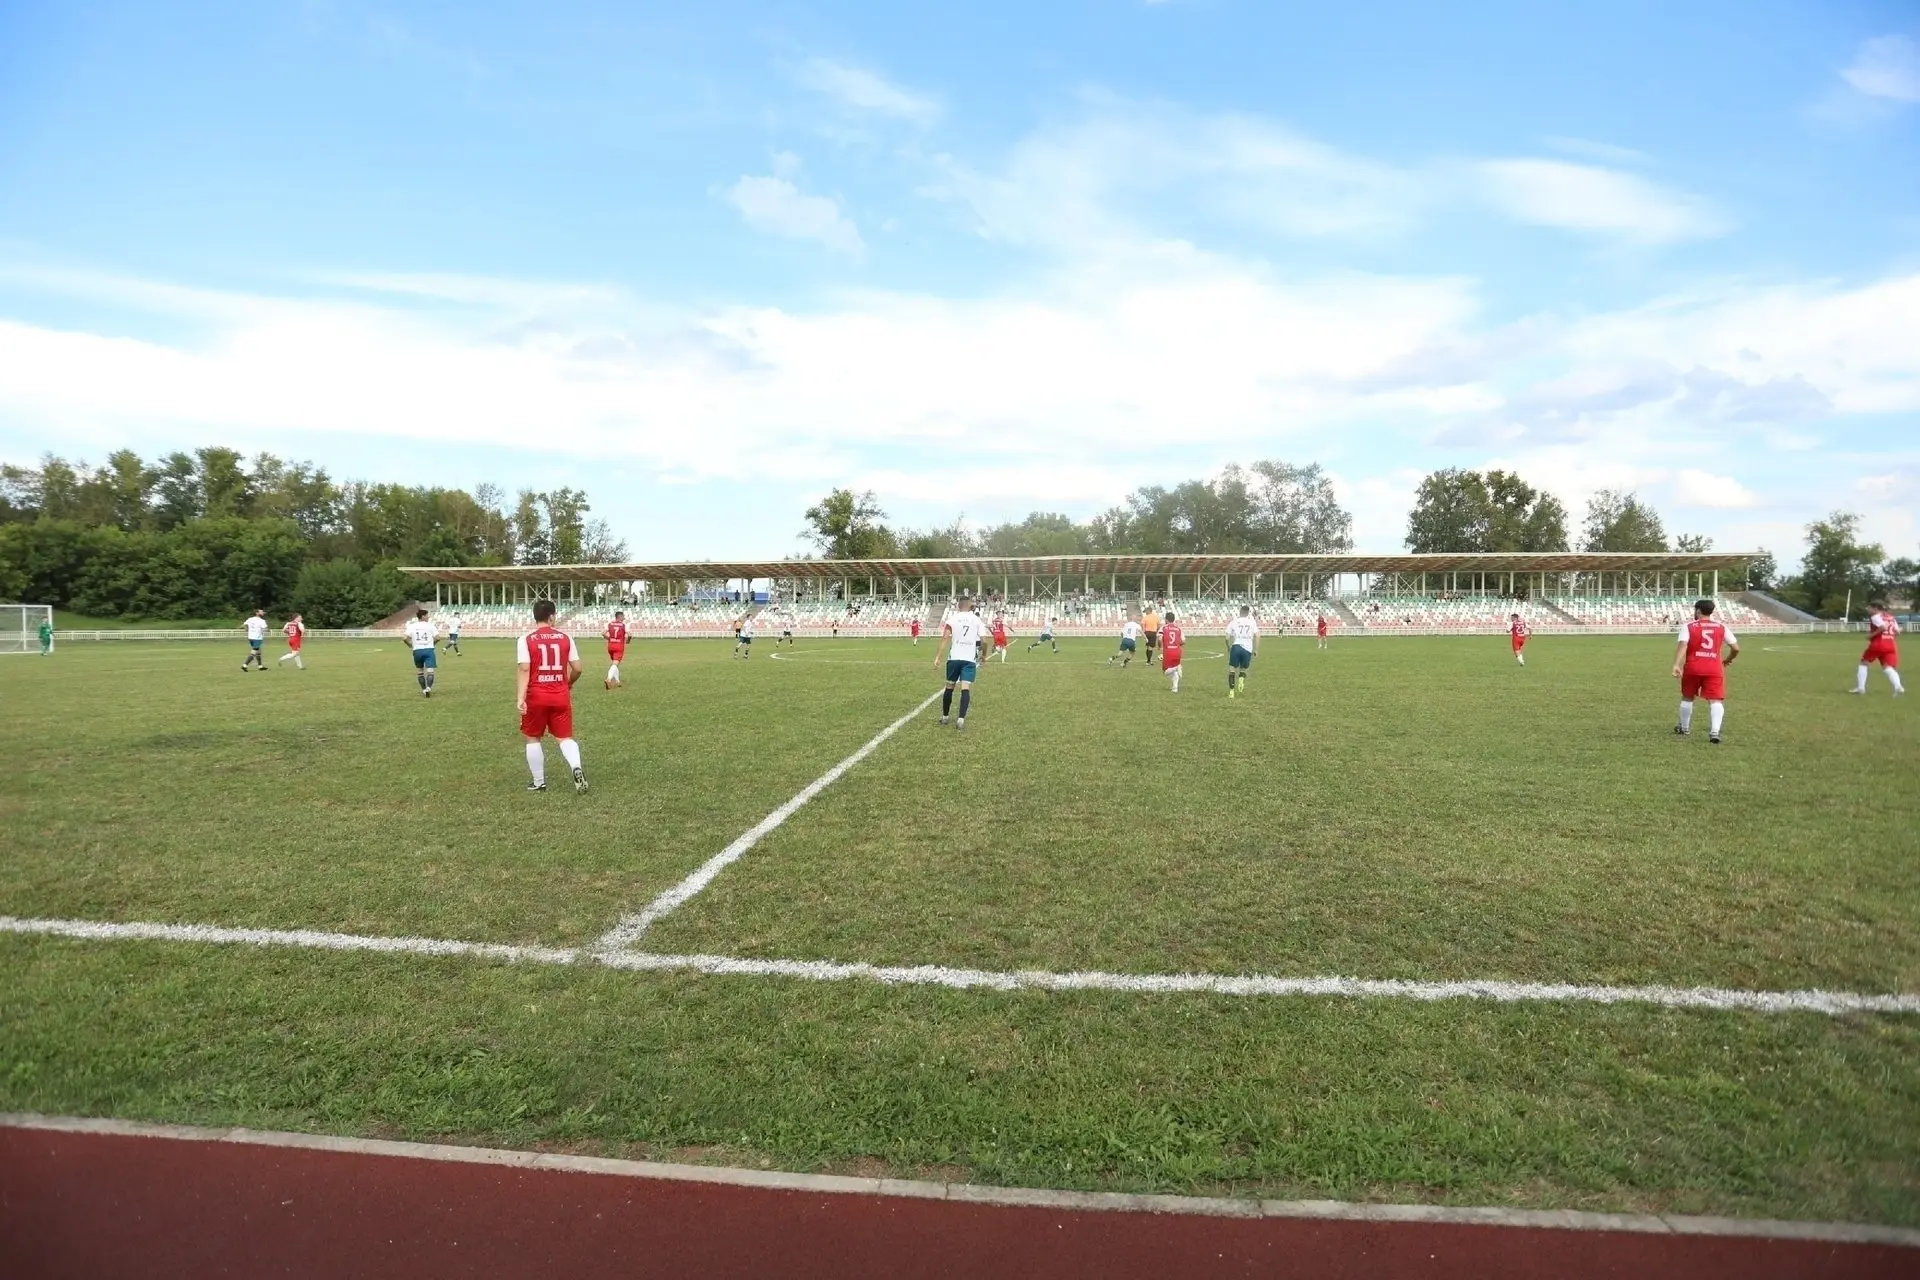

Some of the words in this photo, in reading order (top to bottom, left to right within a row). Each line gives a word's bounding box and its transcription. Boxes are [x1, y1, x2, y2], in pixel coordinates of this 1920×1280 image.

[612, 626, 620, 638] 7
[962, 625, 970, 637] 7
[1239, 625, 1251, 634] 77
[415, 631, 429, 641] 14
[1168, 631, 1176, 644] 9
[1701, 629, 1715, 649] 5
[538, 643, 563, 671] 11
